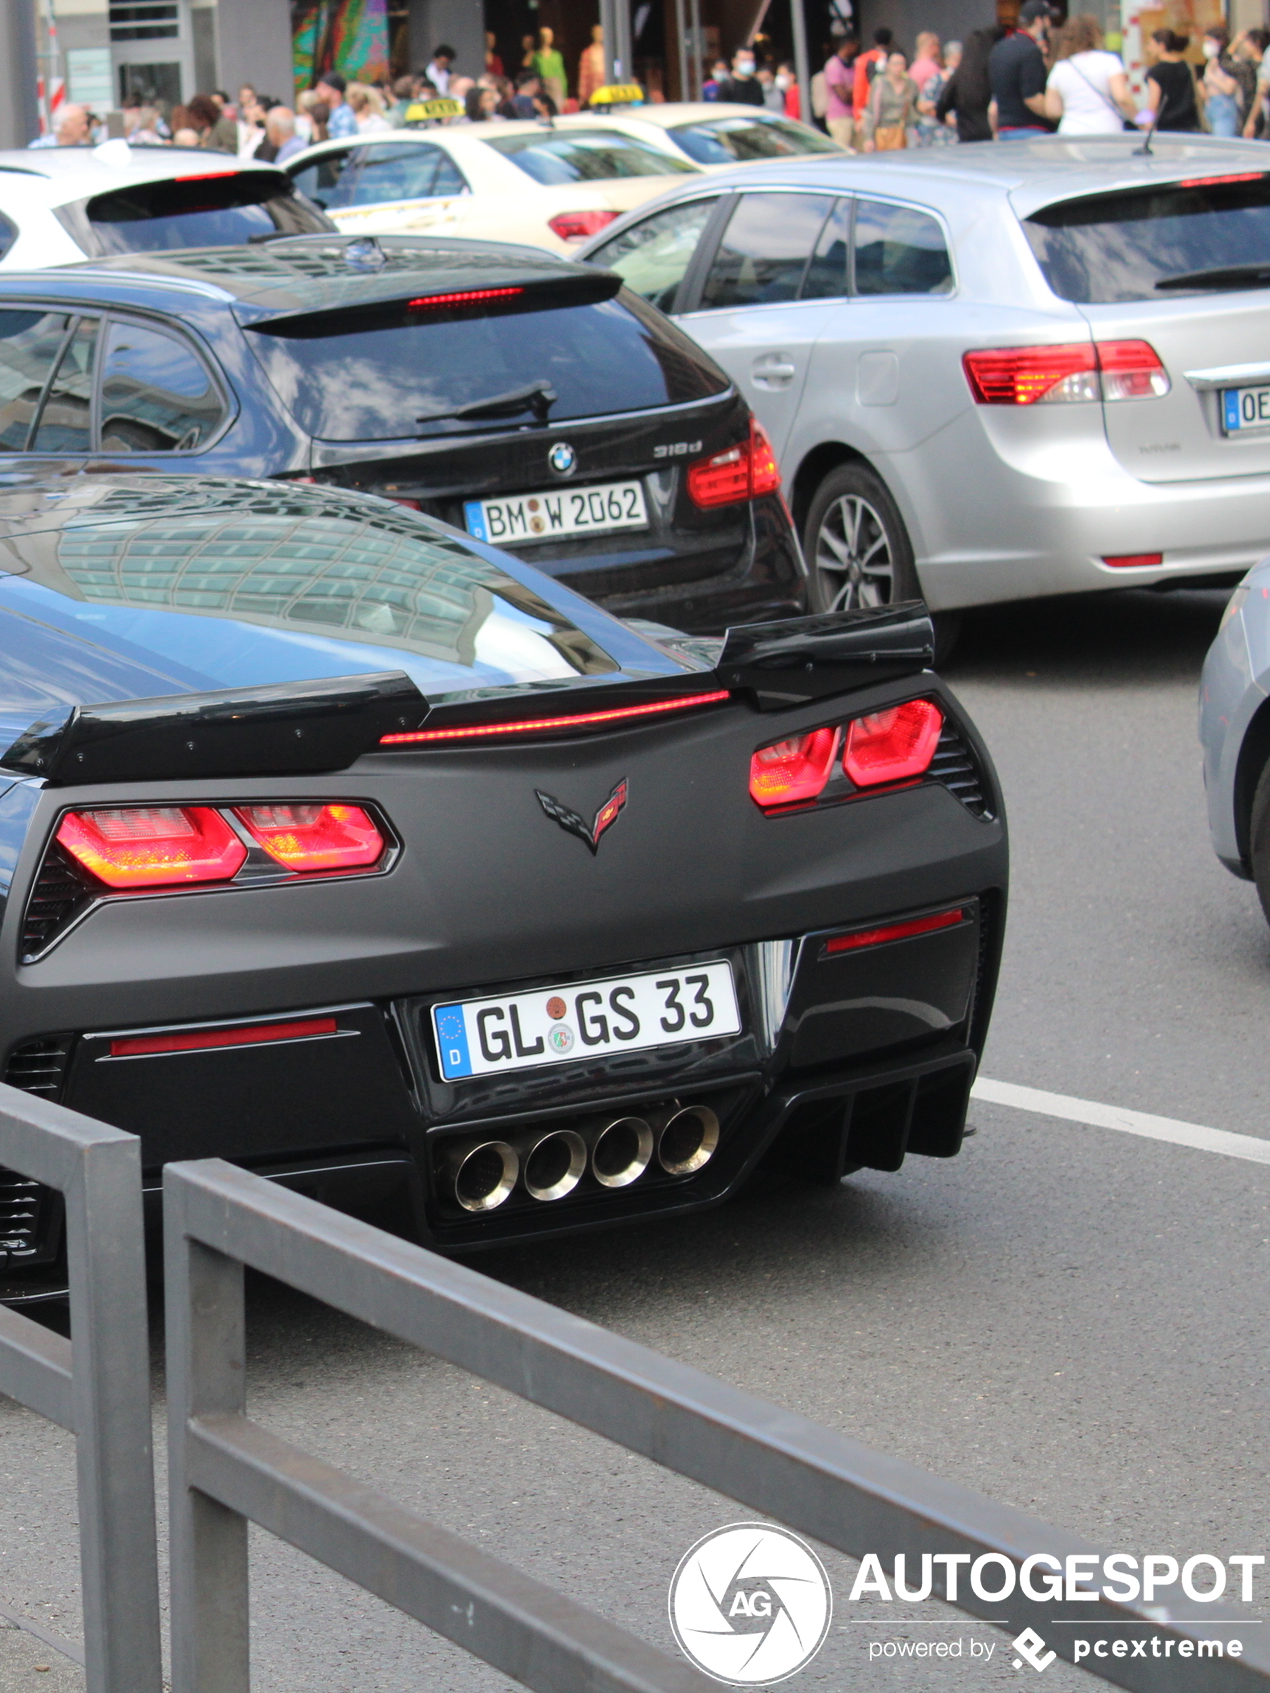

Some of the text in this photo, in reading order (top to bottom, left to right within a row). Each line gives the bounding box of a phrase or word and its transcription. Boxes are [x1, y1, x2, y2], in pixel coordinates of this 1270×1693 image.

[486, 488, 641, 537] BM W 2062
[476, 1003, 545, 1062] GL
[575, 986, 641, 1046] GS
[655, 974, 715, 1033] 33
[449, 1049, 462, 1066] D
